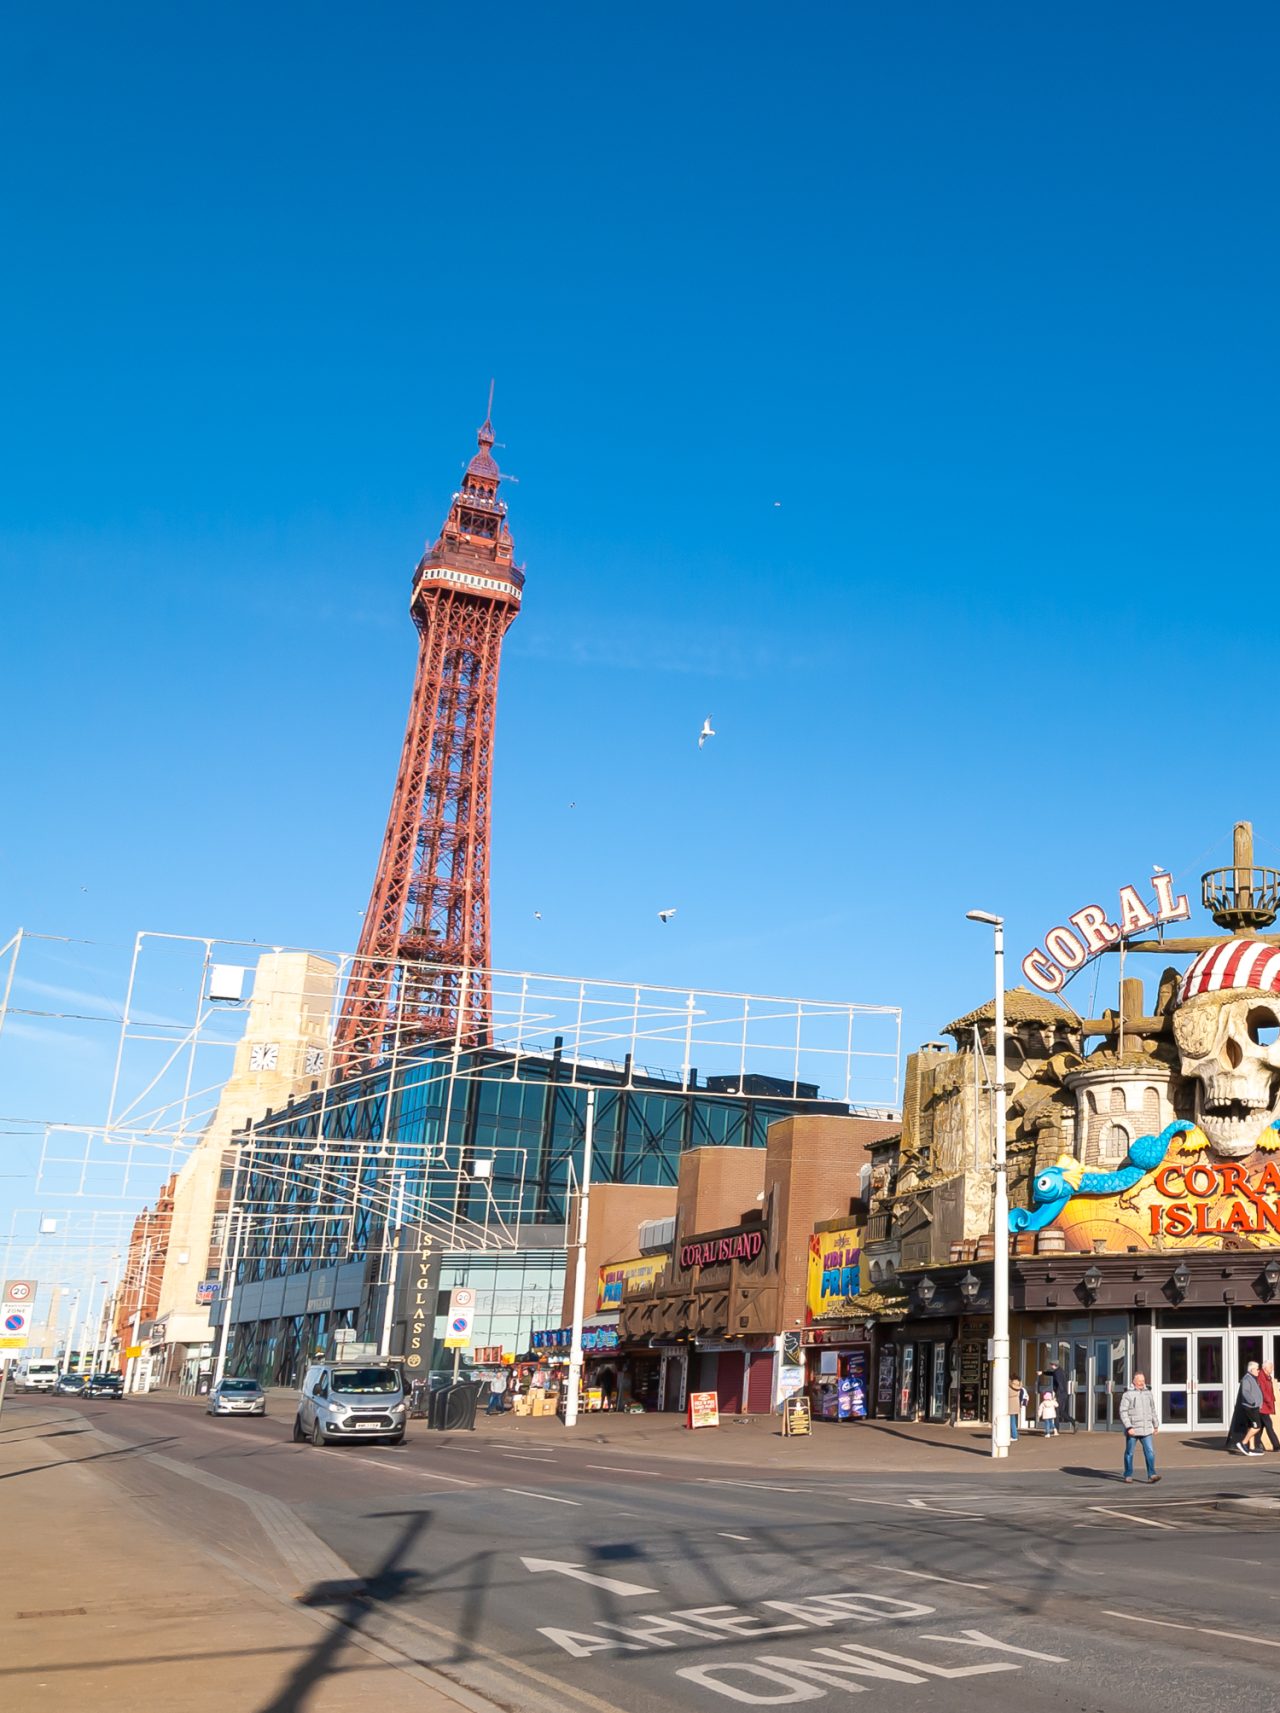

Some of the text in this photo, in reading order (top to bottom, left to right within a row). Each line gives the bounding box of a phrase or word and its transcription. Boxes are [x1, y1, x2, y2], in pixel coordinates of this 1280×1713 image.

[1021, 872, 1191, 993] CORAL
[681, 1232, 762, 1268] CORAL ISLAND
[824, 1250, 843, 1270] KIDS
[13, 1287, 27, 1295] 20
[411, 1234, 432, 1349] SPYGLASS
[821, 1266, 861, 1298] FREE
[536, 1593, 936, 1657] AHEAD
[675, 1629, 1070, 1704] ONLY
